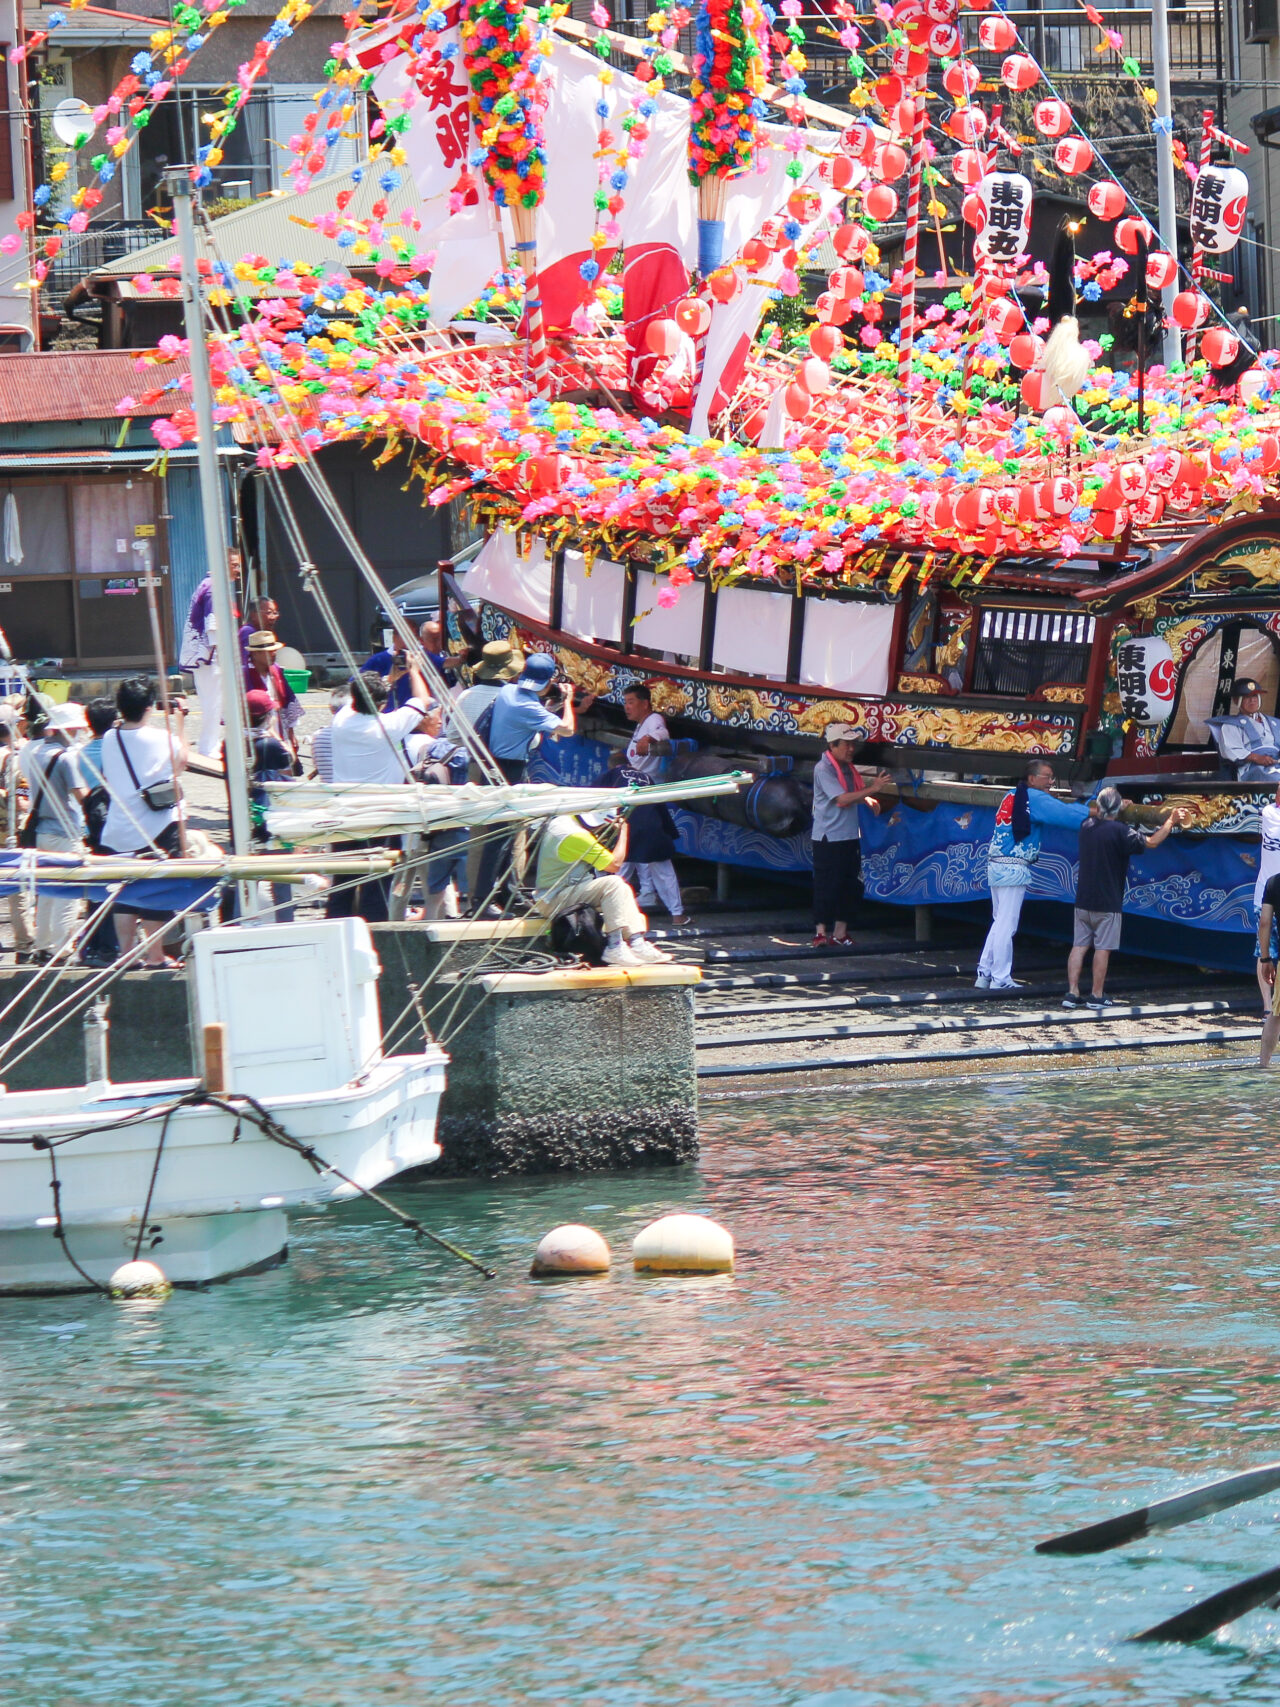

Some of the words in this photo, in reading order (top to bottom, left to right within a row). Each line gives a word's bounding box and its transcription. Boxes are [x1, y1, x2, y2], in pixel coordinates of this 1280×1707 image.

[934, 29, 952, 48] 東
[980, 24, 991, 41] 東
[893, 51, 905, 65] 東
[1003, 61, 1015, 78] 東
[1039, 109, 1056, 126] 東
[844, 129, 862, 147] 東
[1057, 144, 1073, 164] 東
[818, 160, 830, 180] 東
[952, 157, 965, 174] 東
[1090, 187, 1102, 205] 東
[986, 181, 1024, 255] 東明丸
[1192, 174, 1225, 248] 東明丸
[761, 219, 776, 238] 東
[852, 236, 869, 254] 東
[1146, 259, 1162, 278] 東
[829, 272, 842, 289] 東
[817, 296, 831, 312] 東
[989, 308, 1001, 322] 東
[1228, 342, 1240, 357] 東
[1156, 457, 1176, 477] 東
[1125, 470, 1144, 491] 東
[1058, 483, 1075, 503] 東
[1169, 484, 1190, 500] 東
[997, 493, 1014, 513] 東
[1133, 499, 1153, 515] 東
[1119, 644, 1150, 720] 東明丸
